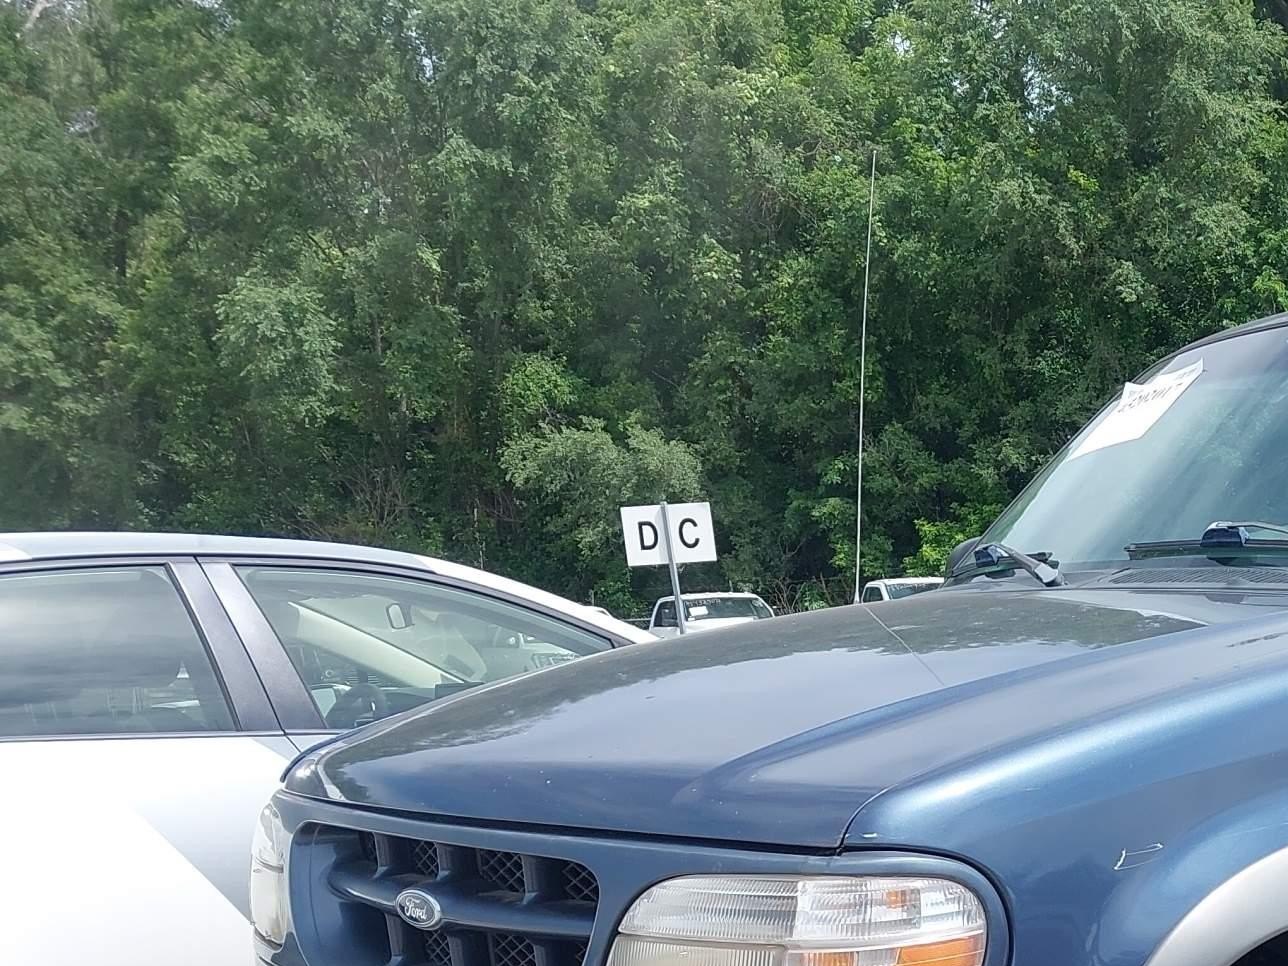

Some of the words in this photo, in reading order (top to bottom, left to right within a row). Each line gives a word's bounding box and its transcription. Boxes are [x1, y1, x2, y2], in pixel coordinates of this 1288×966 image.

[637, 520, 659, 551] D
[678, 517, 700, 549] C
[404, 896, 428, 920] Ford
